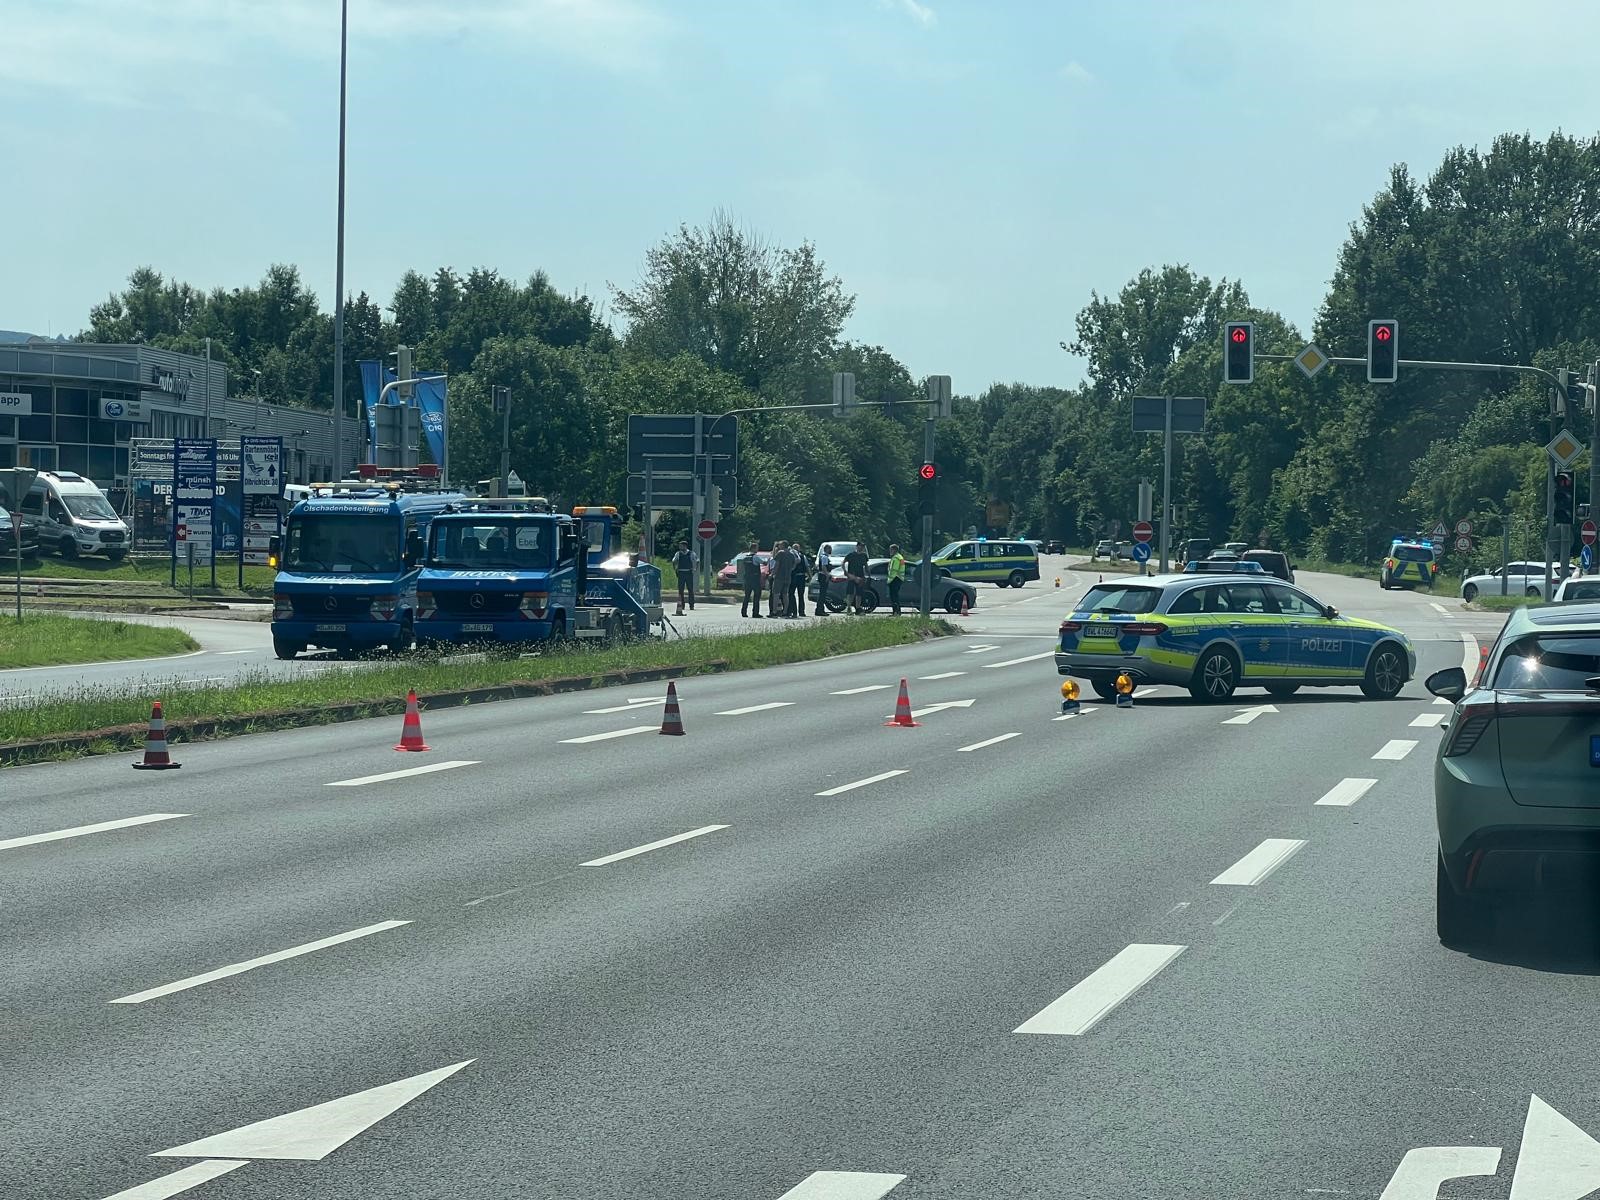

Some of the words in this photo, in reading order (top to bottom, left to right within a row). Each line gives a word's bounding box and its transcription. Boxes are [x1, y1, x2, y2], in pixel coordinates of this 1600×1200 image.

[140, 452, 166, 460] Sonntags
[222, 453, 229, 461] 16
[229, 453, 240, 461] Uhr
[153, 484, 173, 495] DER
[1301, 638, 1343, 652] POLIZEI
